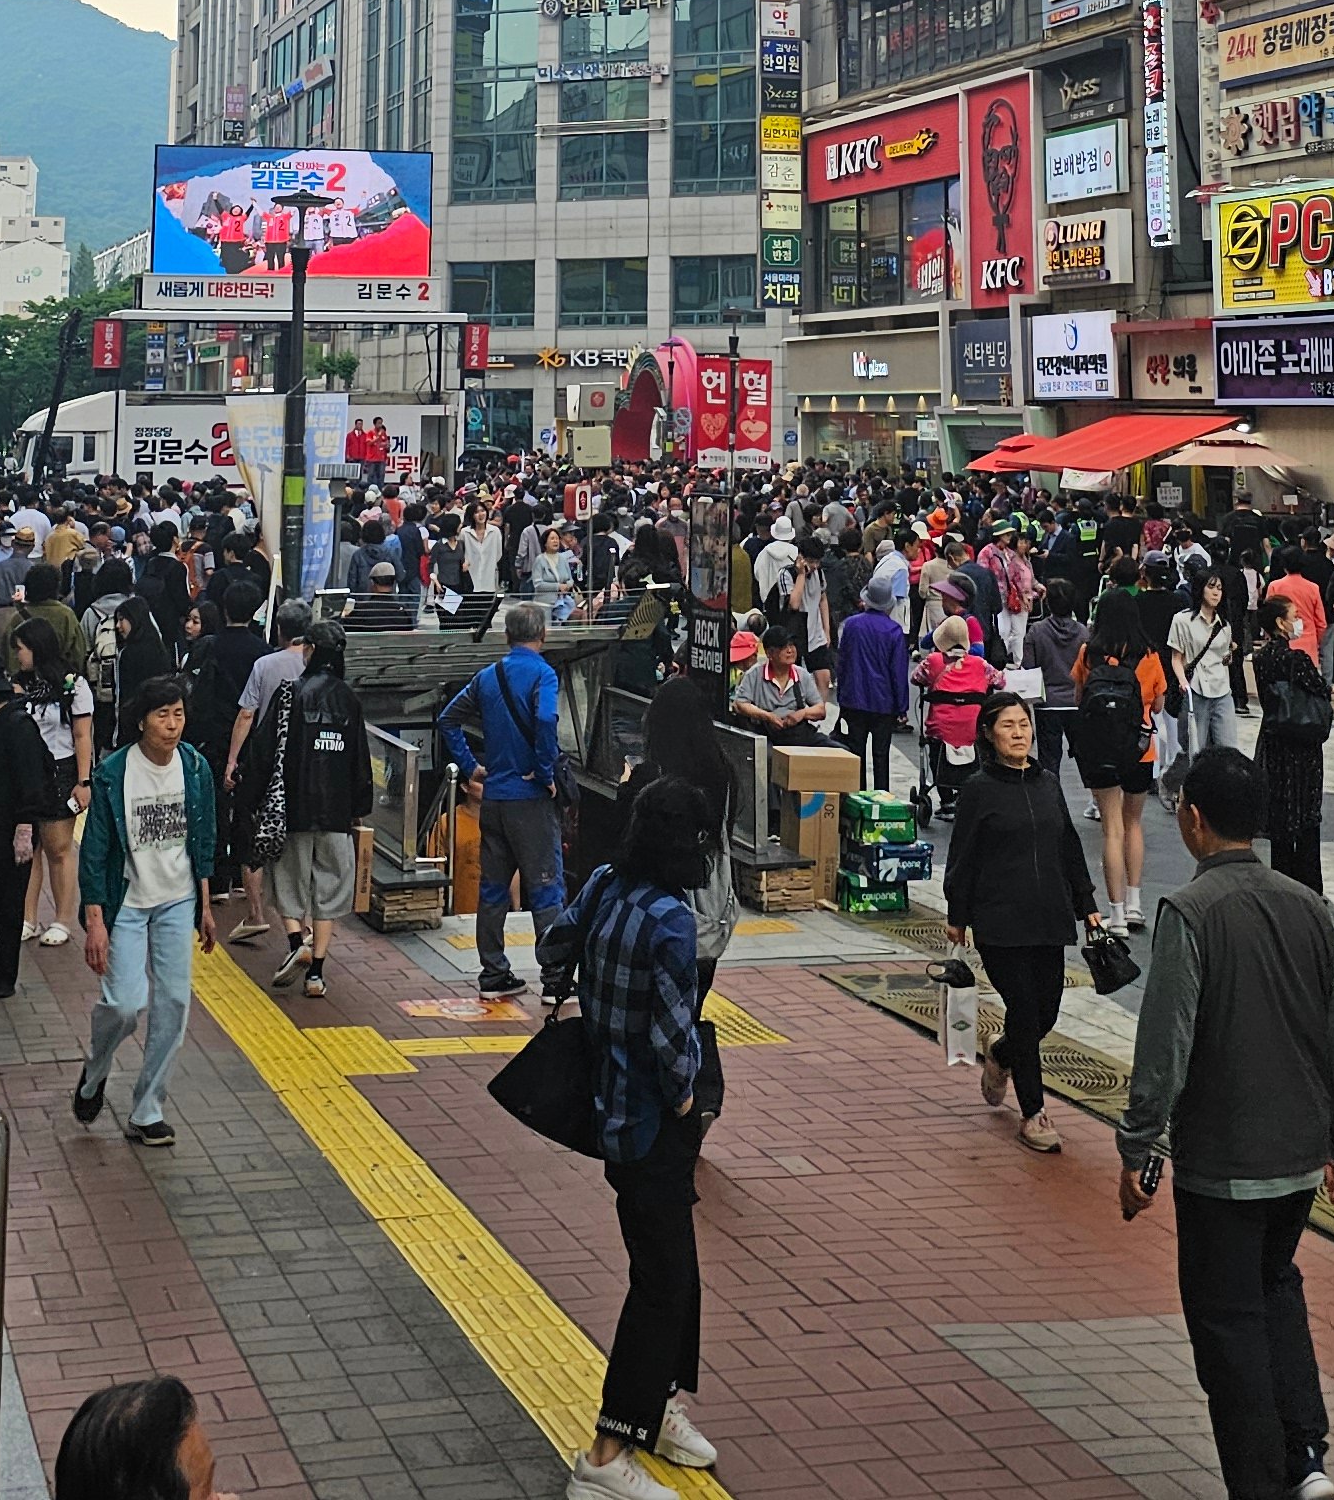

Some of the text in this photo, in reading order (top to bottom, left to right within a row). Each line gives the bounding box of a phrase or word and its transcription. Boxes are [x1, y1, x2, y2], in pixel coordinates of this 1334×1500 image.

[771, 8, 789, 29] 약
[1225, 32, 1258, 64] 24시
[762, 54, 800, 74] 한의원
[840, 133, 885, 172] KFC
[1052, 148, 1099, 177] 보배반점
[250, 162, 347, 193] 김문수 2
[1058, 221, 1103, 244] LUNA
[15, 275, 31, 285] LH
[979, 256, 1025, 292] KFC
[156, 281, 276, 299] 새롭게 대한민국!
[357, 282, 430, 301] 김문수 2
[762, 283, 801, 307] 치과
[1220, 339, 1277, 377] 아마존
[133, 438, 210, 467] 김문수
[693, 619, 720, 648] ROCK
[313, 738, 345, 752] STUDIO
[873, 819, 907, 833] coupang
[861, 888, 899, 903] coupang
